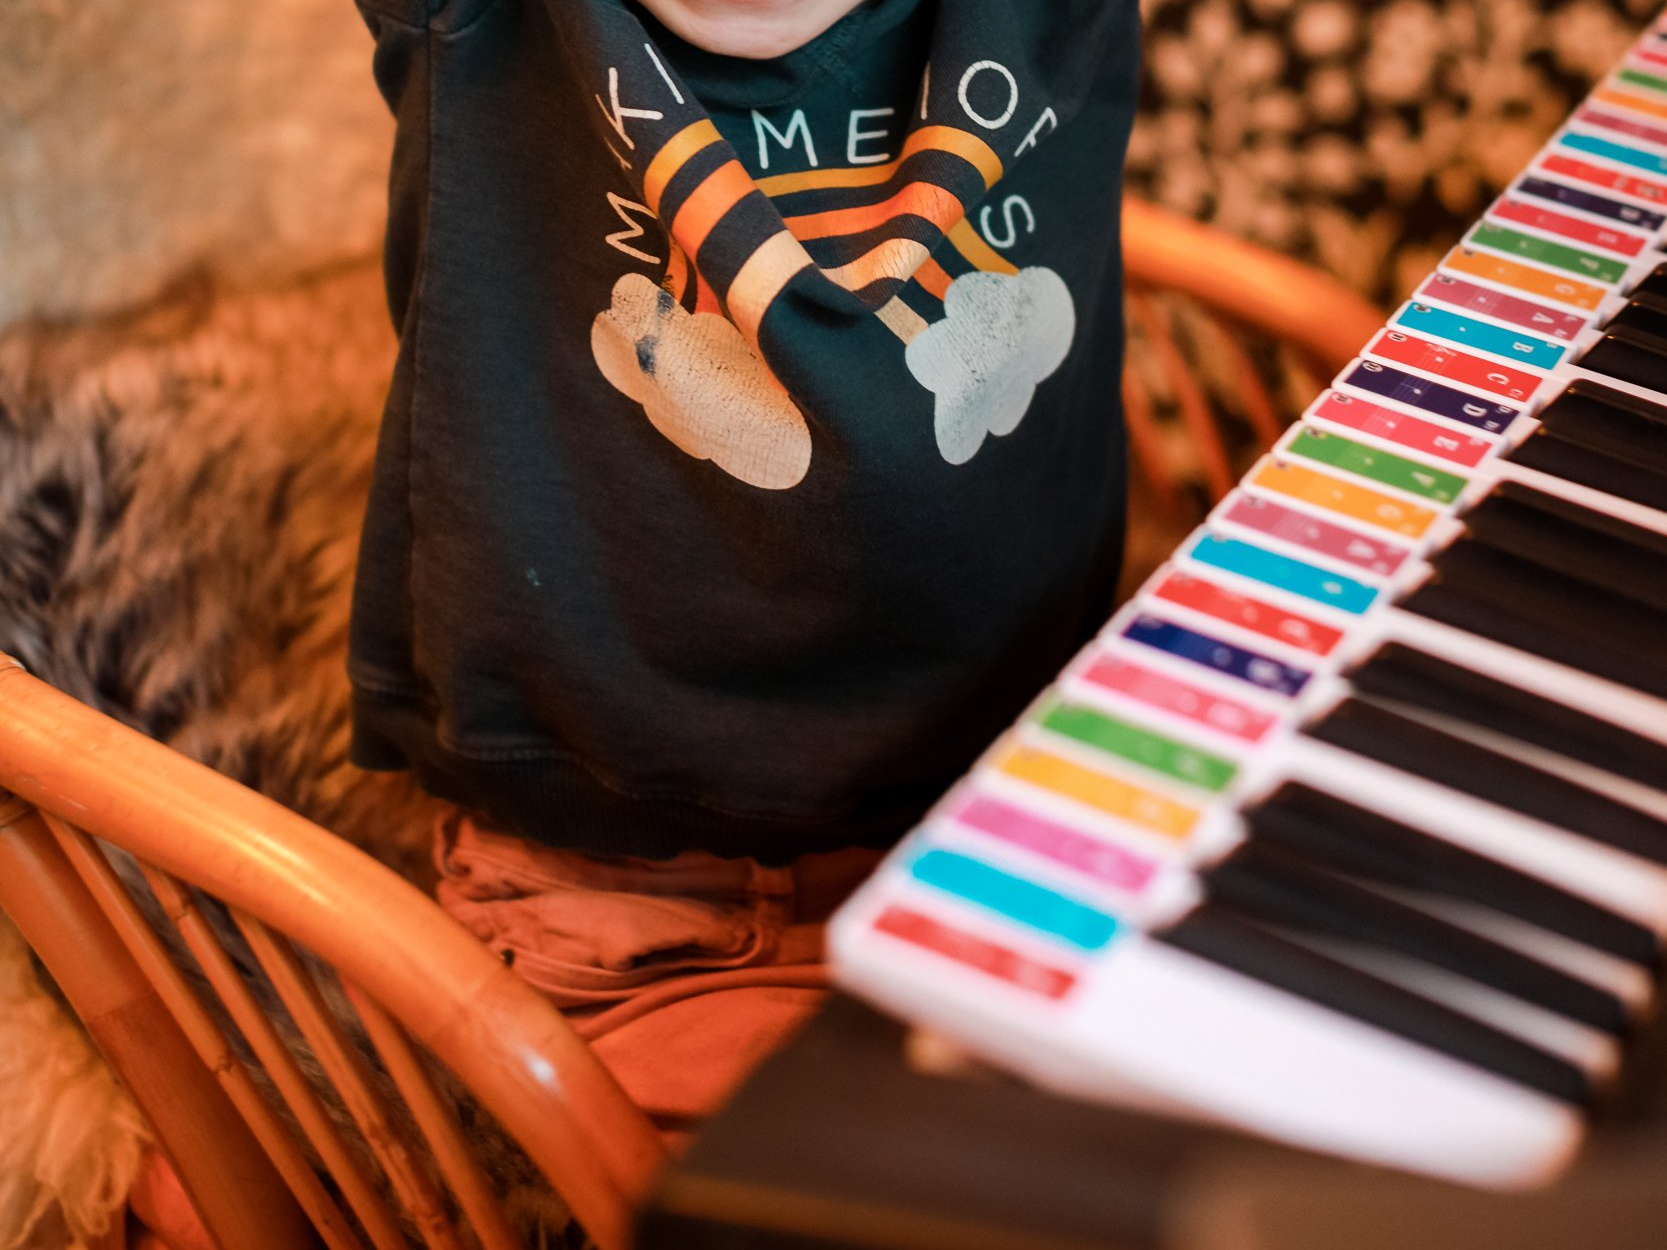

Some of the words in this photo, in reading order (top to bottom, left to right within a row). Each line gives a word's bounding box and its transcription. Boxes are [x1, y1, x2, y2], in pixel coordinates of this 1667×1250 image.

[1531, 312, 1555, 324] A
[1512, 342, 1535, 353] B
[1487, 372, 1510, 385] C
[1463, 403, 1487, 417] D
[1433, 435, 1459, 451] E
